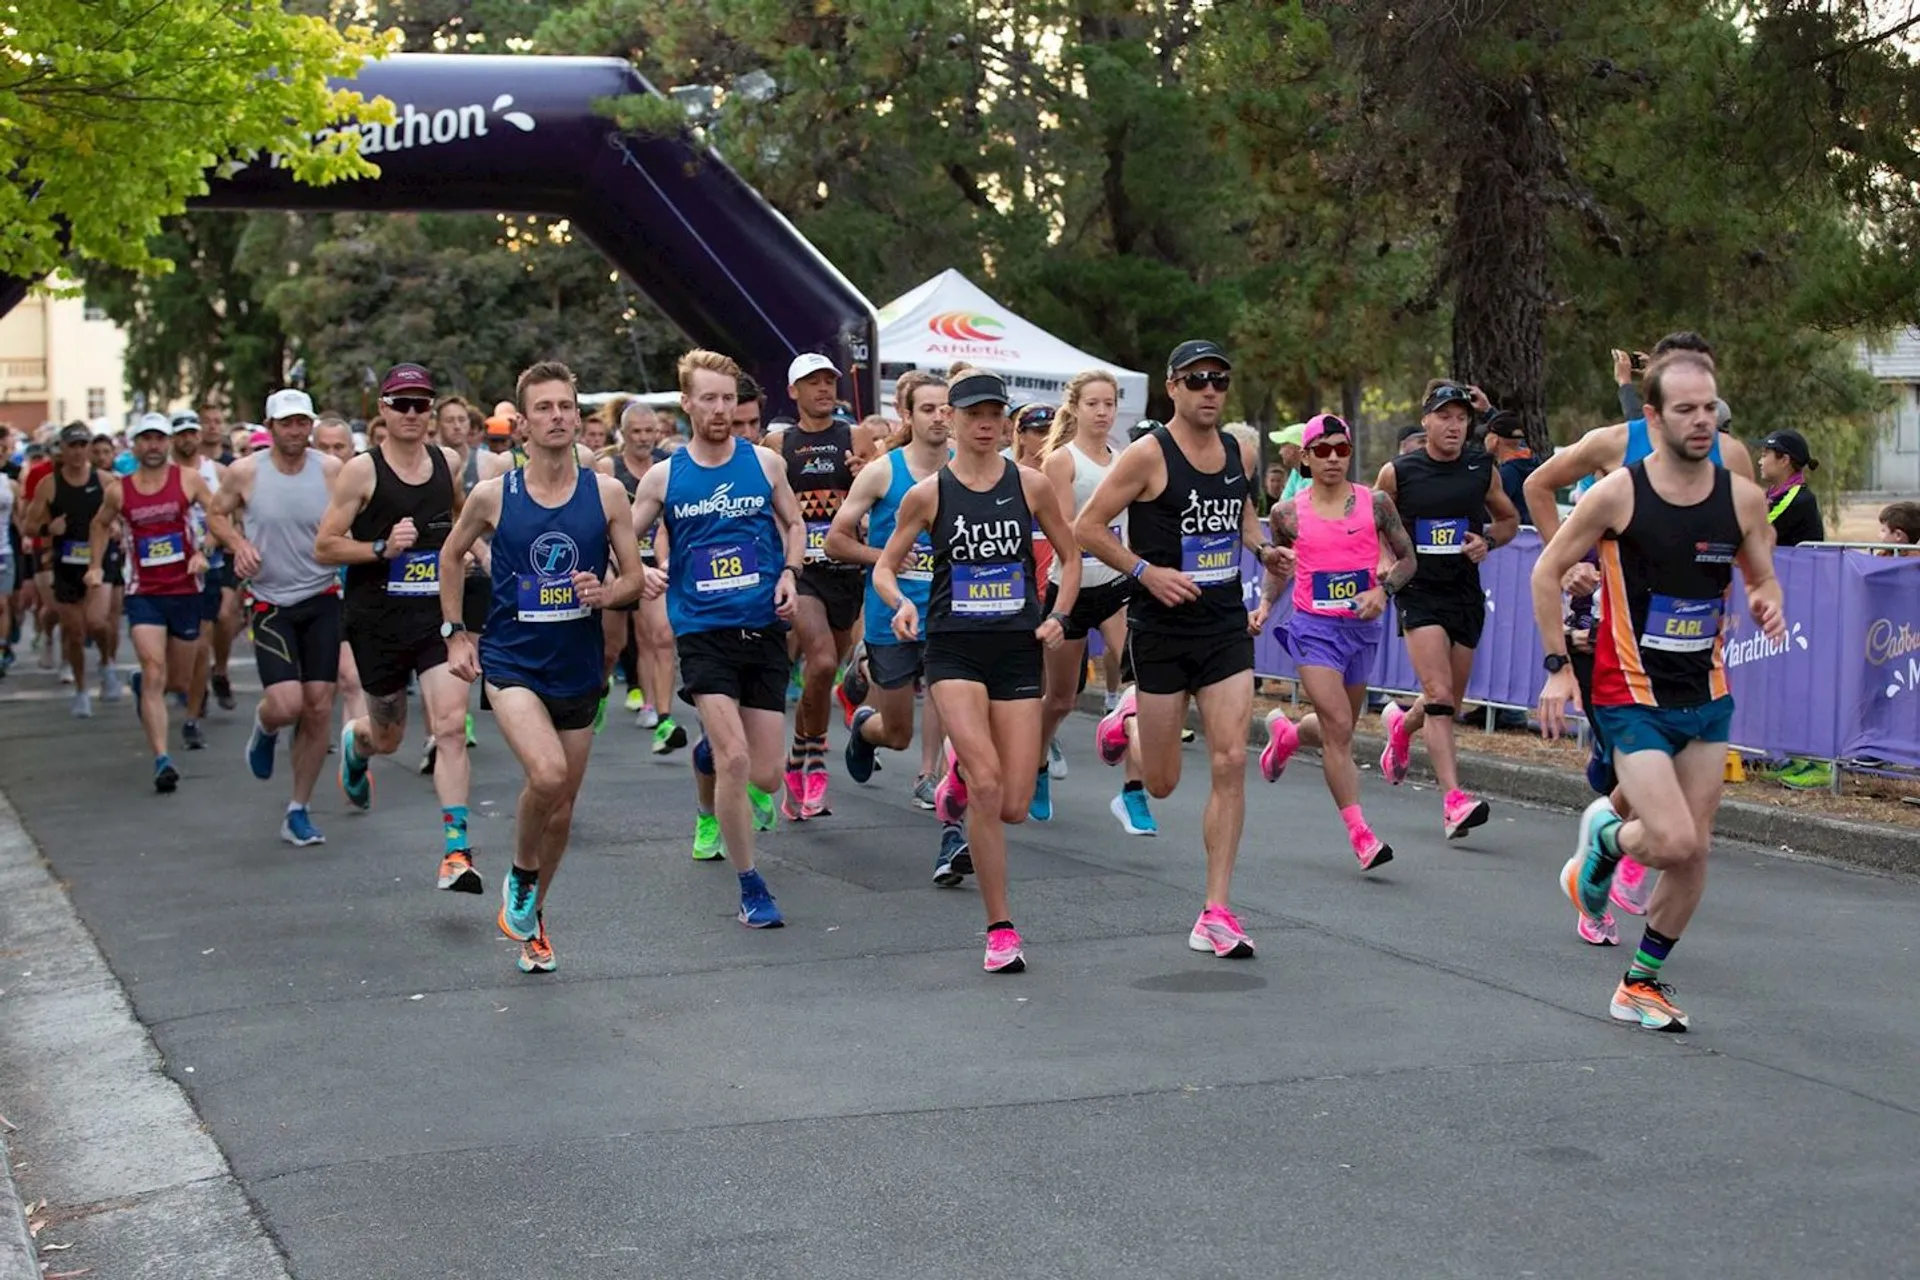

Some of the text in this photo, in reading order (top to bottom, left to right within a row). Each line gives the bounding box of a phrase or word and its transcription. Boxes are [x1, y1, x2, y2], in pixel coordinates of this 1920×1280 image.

[926, 343, 1020, 359] Athletics
[1015, 374, 1058, 392] DESTROY
[673, 494, 765, 519] Melbourne
[719, 507, 748, 519] Pack
[1203, 498, 1243, 516] run
[971, 519, 1021, 542] run
[1180, 514, 1240, 534] crew
[1430, 528, 1456, 546] 187
[951, 537, 1023, 561] crew
[710, 556, 743, 579] 128
[1197, 551, 1233, 568] SAINT
[403, 562, 436, 582] 294
[540, 586, 573, 605] BISH
[969, 582, 1012, 599] KATIE
[1327, 581, 1357, 599] 160
[1665, 618, 1704, 636] EARL
